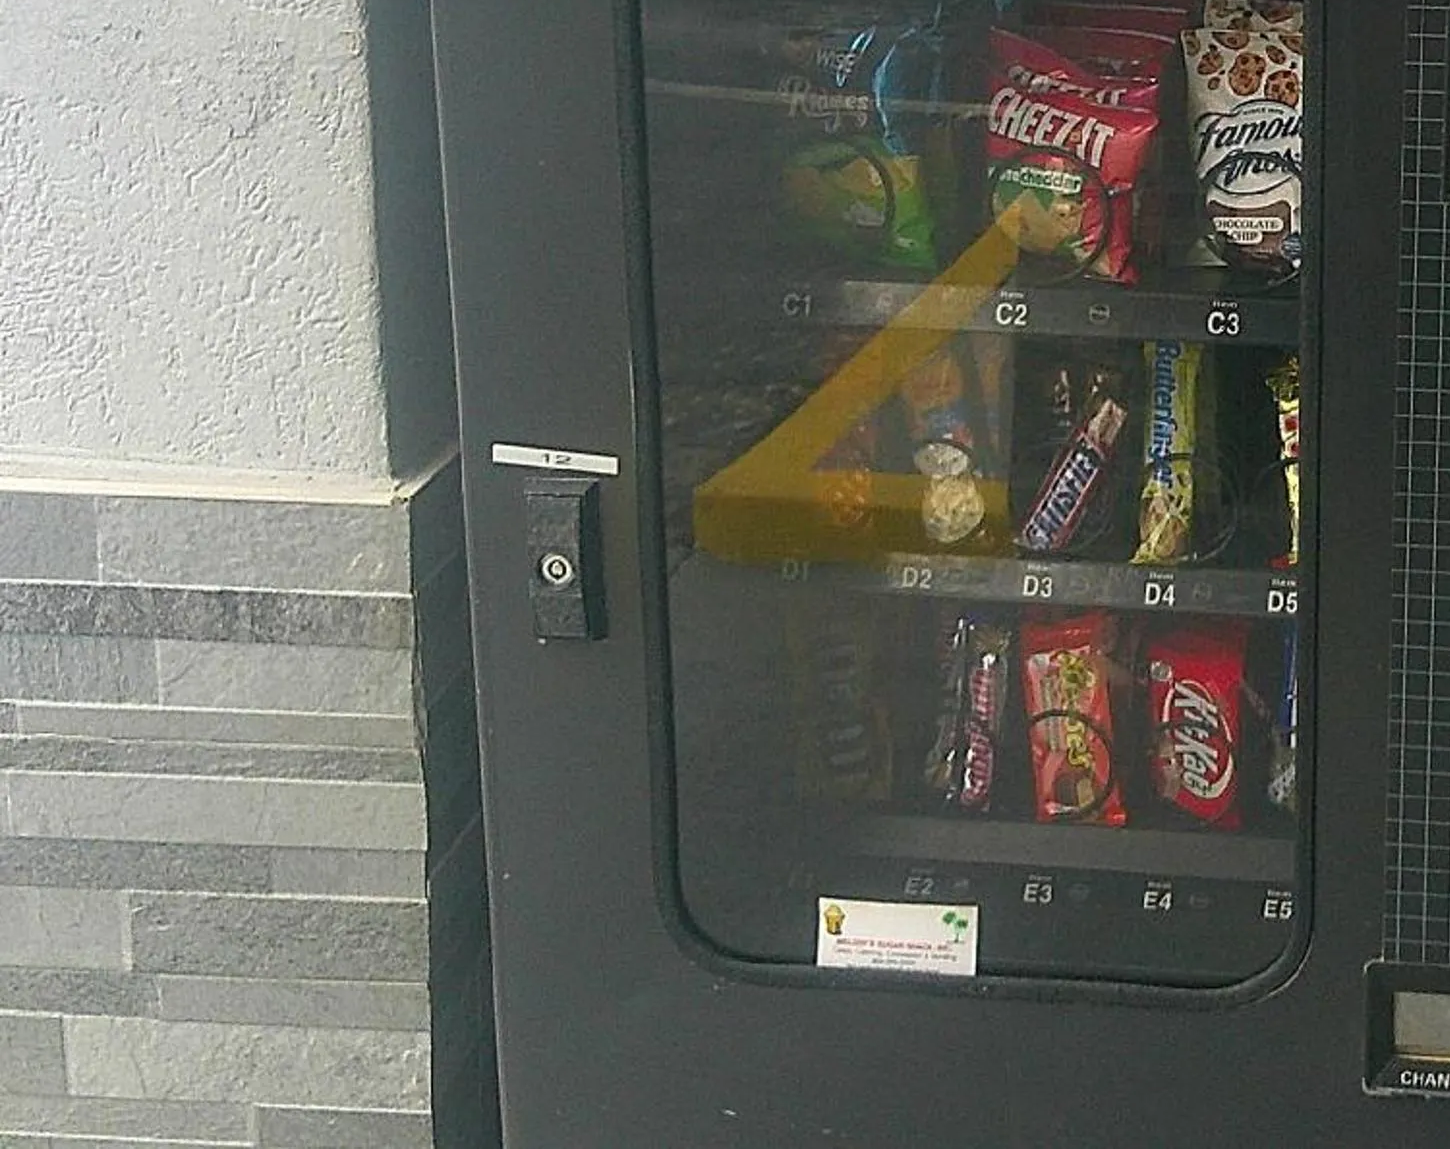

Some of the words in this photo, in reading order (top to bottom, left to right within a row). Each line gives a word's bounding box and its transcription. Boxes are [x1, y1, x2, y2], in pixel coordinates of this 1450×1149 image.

[782, 293, 812, 316] C1
[995, 303, 1028, 327] C2
[1206, 311, 1240, 336] C3
[541, 453, 572, 464] 12
[902, 567, 932, 590] D2
[1022, 575, 1053, 598] D3
[1144, 582, 1176, 607] D4
[1267, 590, 1298, 615] D5
[904, 876, 935, 895] E2
[1023, 884, 1052, 904] E3
[1143, 892, 1172, 912] E4
[1264, 900, 1293, 920] E5
